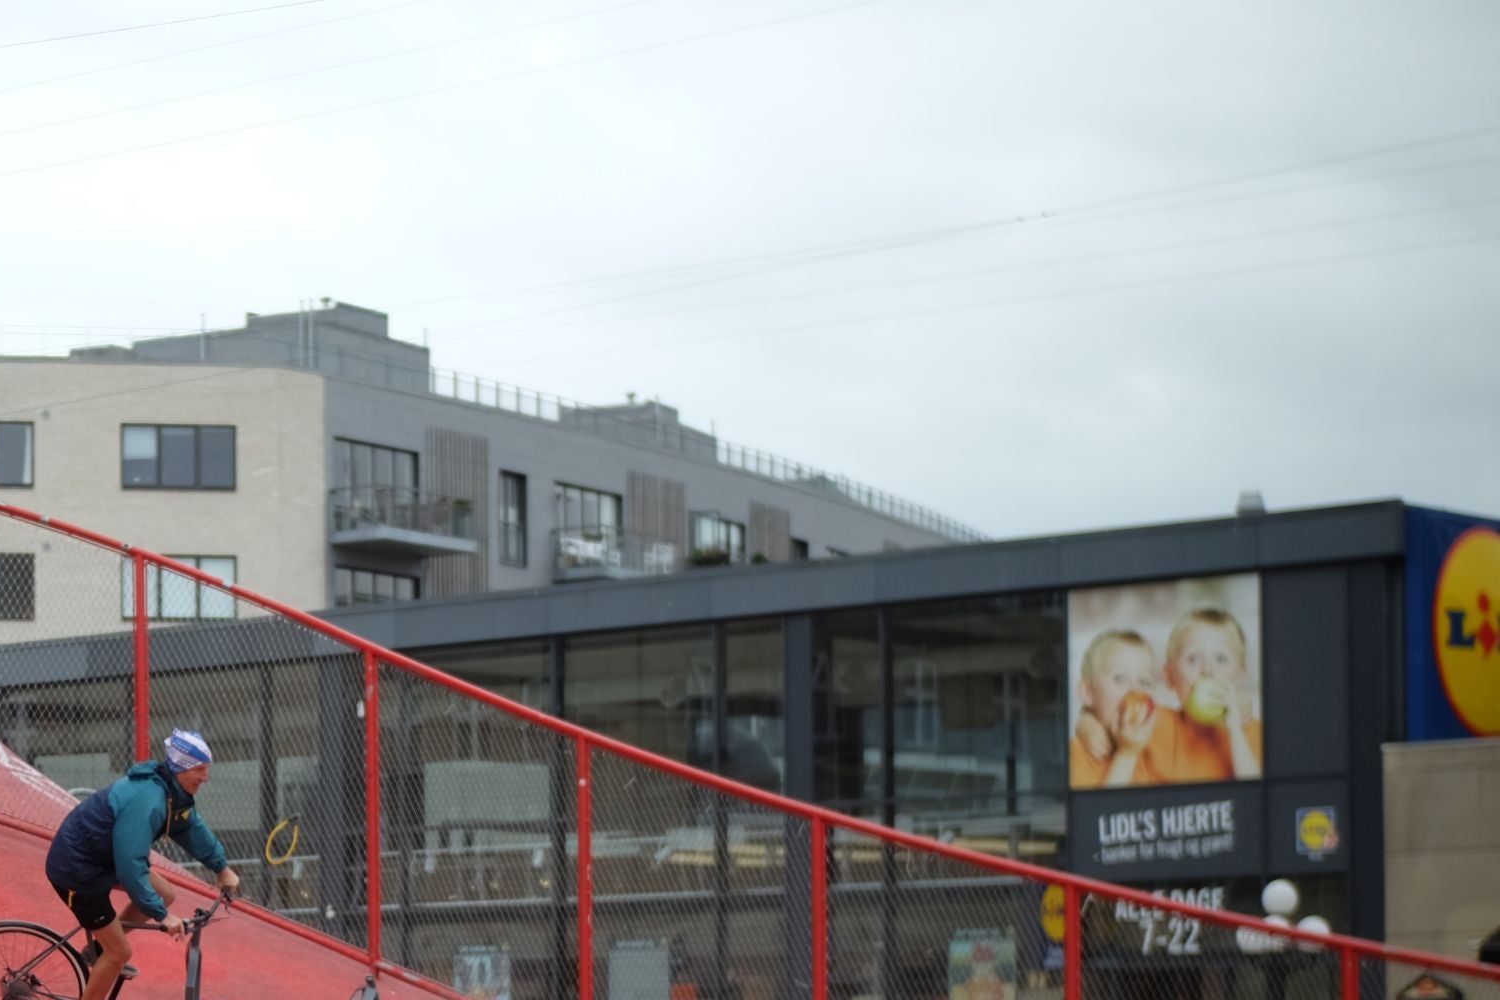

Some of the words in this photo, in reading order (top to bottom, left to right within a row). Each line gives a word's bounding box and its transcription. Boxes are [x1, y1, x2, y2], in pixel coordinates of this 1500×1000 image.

[1099, 808, 1157, 845] LIDL'S
[1162, 800, 1235, 837] HJERTE
[1139, 916, 1202, 956] 7-22
